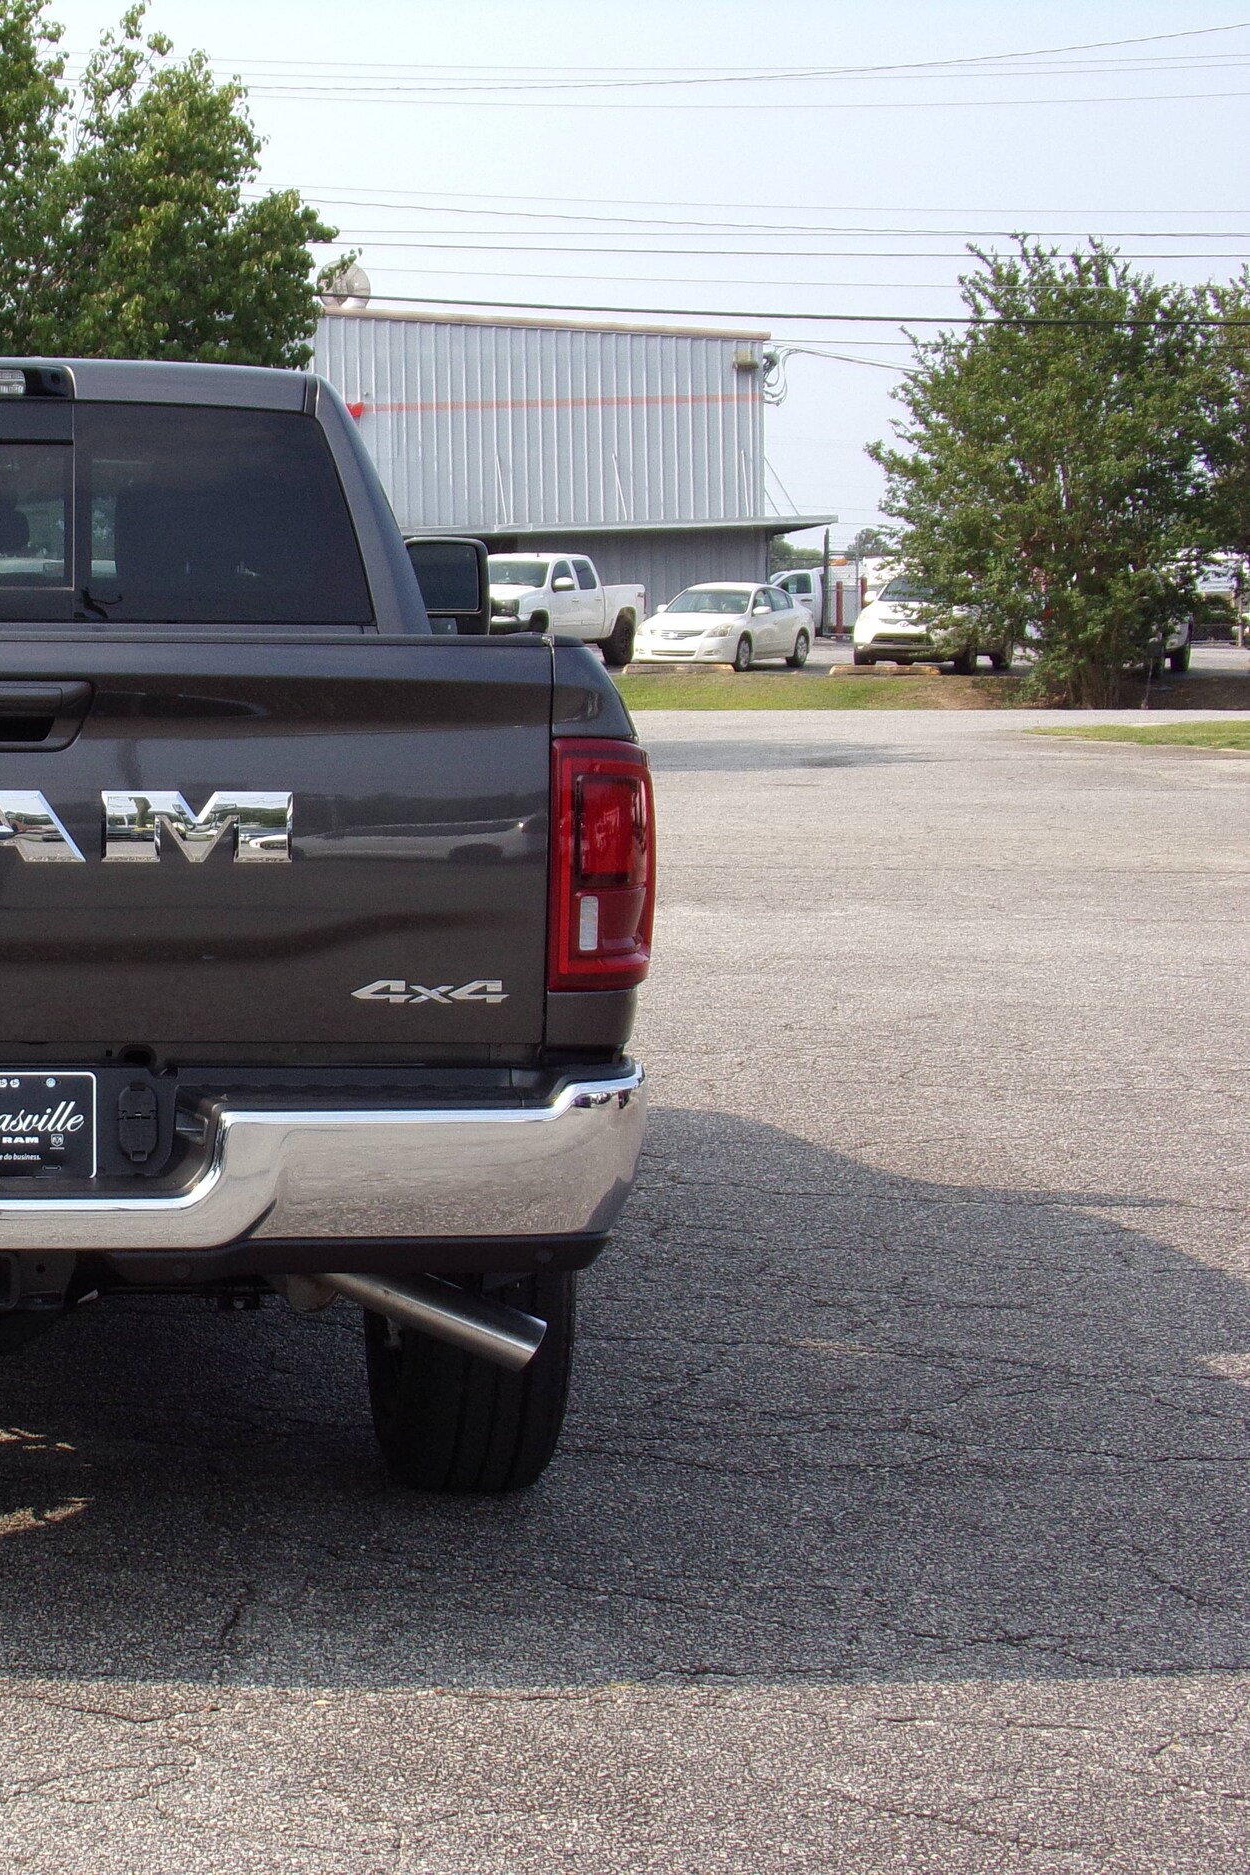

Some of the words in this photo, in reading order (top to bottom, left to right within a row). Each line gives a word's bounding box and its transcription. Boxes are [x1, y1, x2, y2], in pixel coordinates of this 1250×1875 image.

[350, 979, 510, 1003] 4x4
[2, 1136, 39, 1144] RAM
[3, 1152, 12, 1160] do
[13, 1152, 41, 1160] business.
